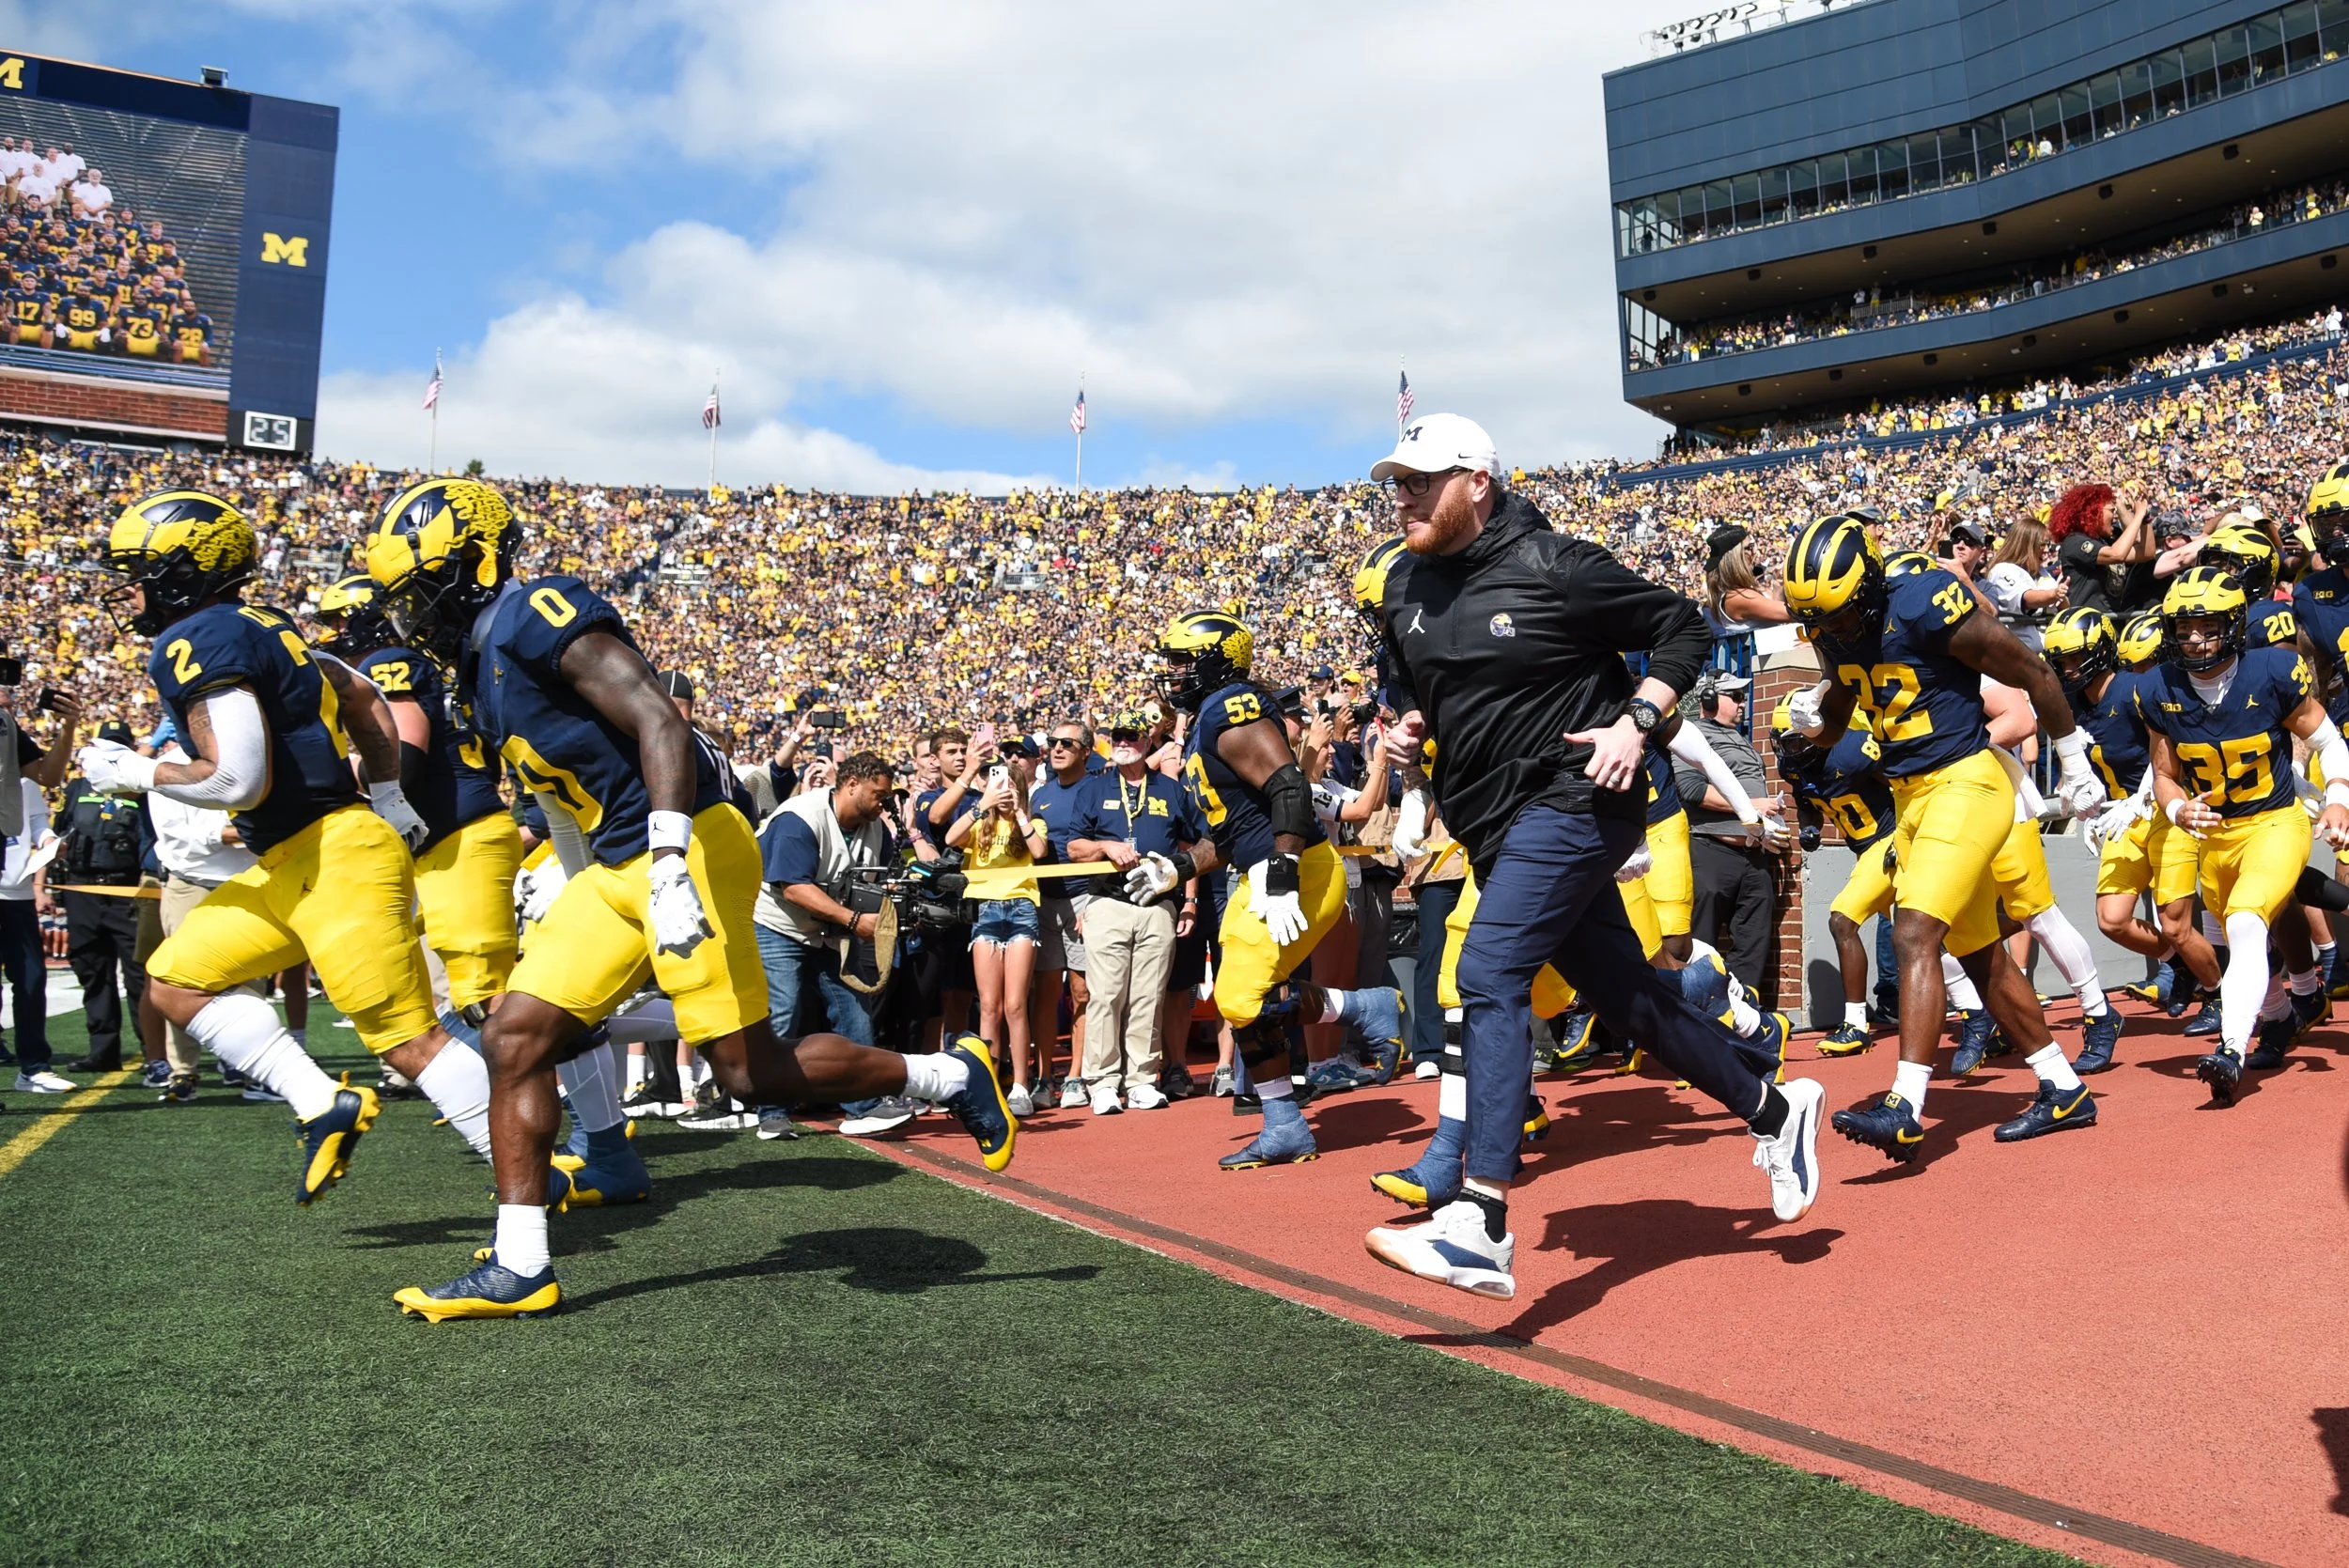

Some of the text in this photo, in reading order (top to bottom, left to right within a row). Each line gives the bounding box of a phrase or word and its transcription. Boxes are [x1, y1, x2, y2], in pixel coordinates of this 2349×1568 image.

[261, 232, 308, 267] M
[17, 301, 39, 321] 17
[70, 309, 96, 327] 99
[126, 317, 153, 337] 73
[251, 417, 289, 444] 25
[1401, 427, 1423, 442] M
[529, 588, 577, 628] 0
[1932, 582, 1973, 625] 32
[2263, 612, 2295, 643] 20
[165, 639, 202, 685] 2
[370, 661, 412, 692] 52
[2291, 654, 2313, 695] 35
[1224, 692, 1261, 724] 53
[1838, 662, 1934, 742] 32
[1860, 733, 1882, 761] 8
[2176, 732, 2275, 807] 35
[1184, 752, 1228, 827] 3
[1313, 792, 1333, 809] 12
[1147, 796, 1169, 817] M
[1887, 1094, 1899, 1105] M
